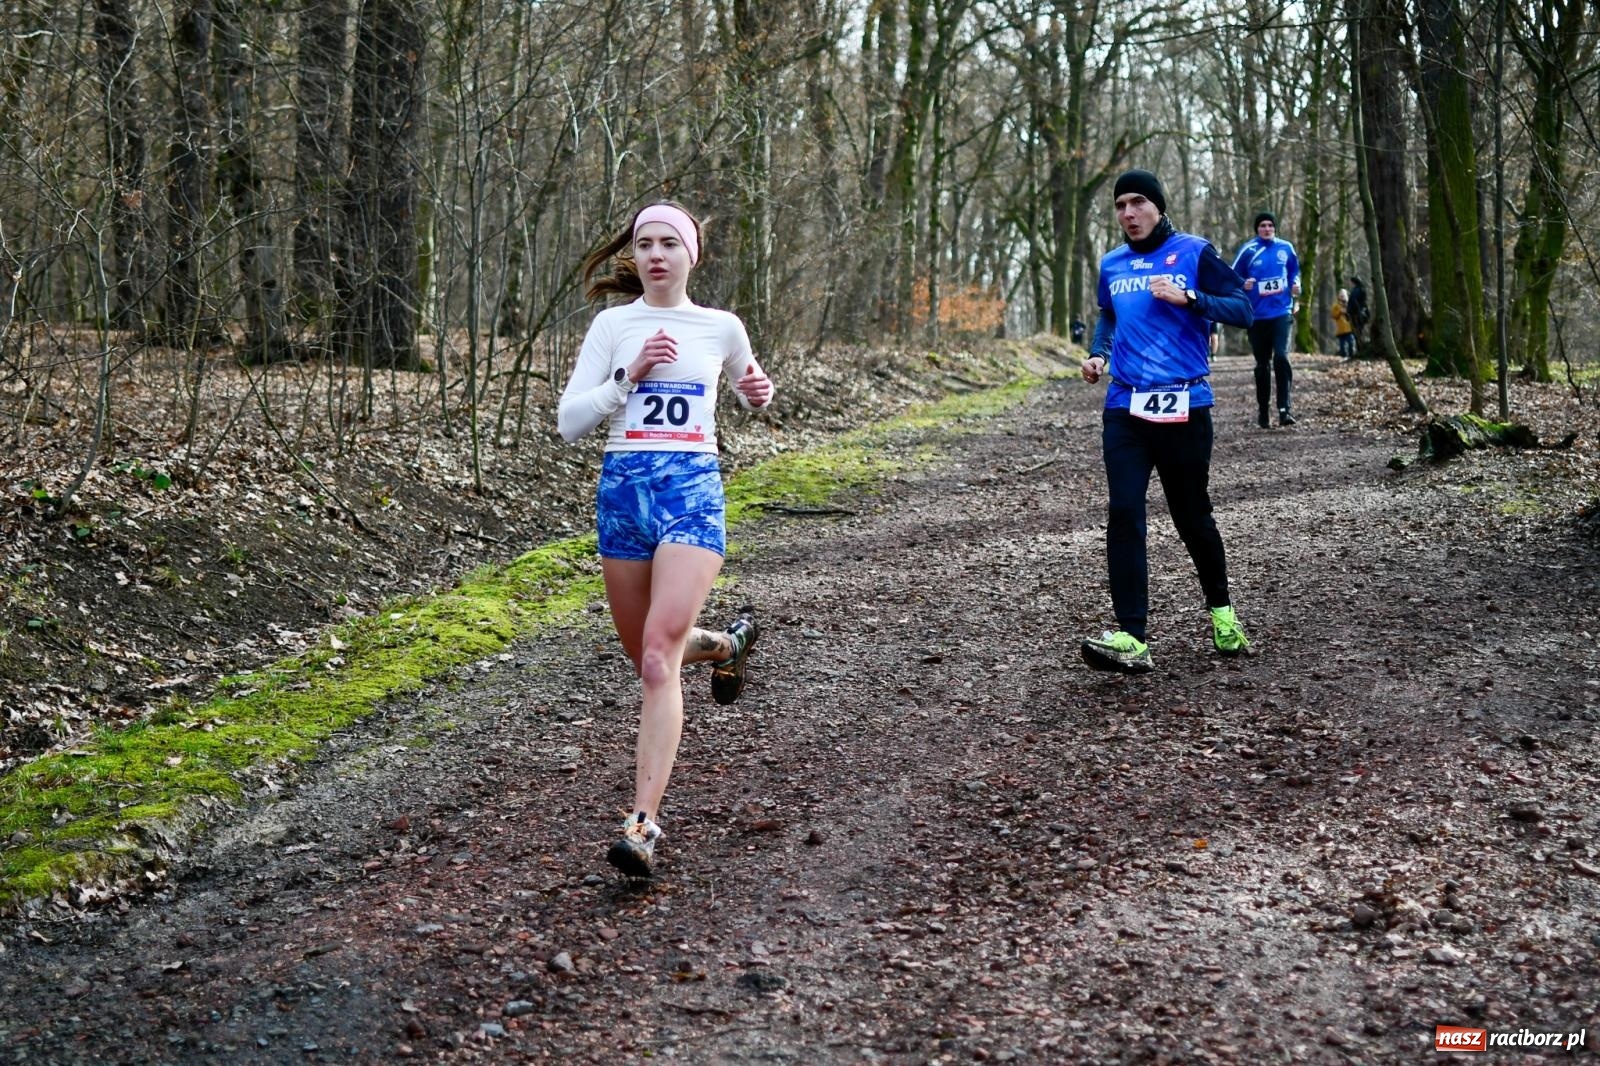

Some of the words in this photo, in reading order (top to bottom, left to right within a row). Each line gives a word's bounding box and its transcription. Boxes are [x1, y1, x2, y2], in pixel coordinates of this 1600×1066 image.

[1264, 280, 1279, 291] 43
[643, 395, 690, 426] 20
[1143, 393, 1178, 414] 42
